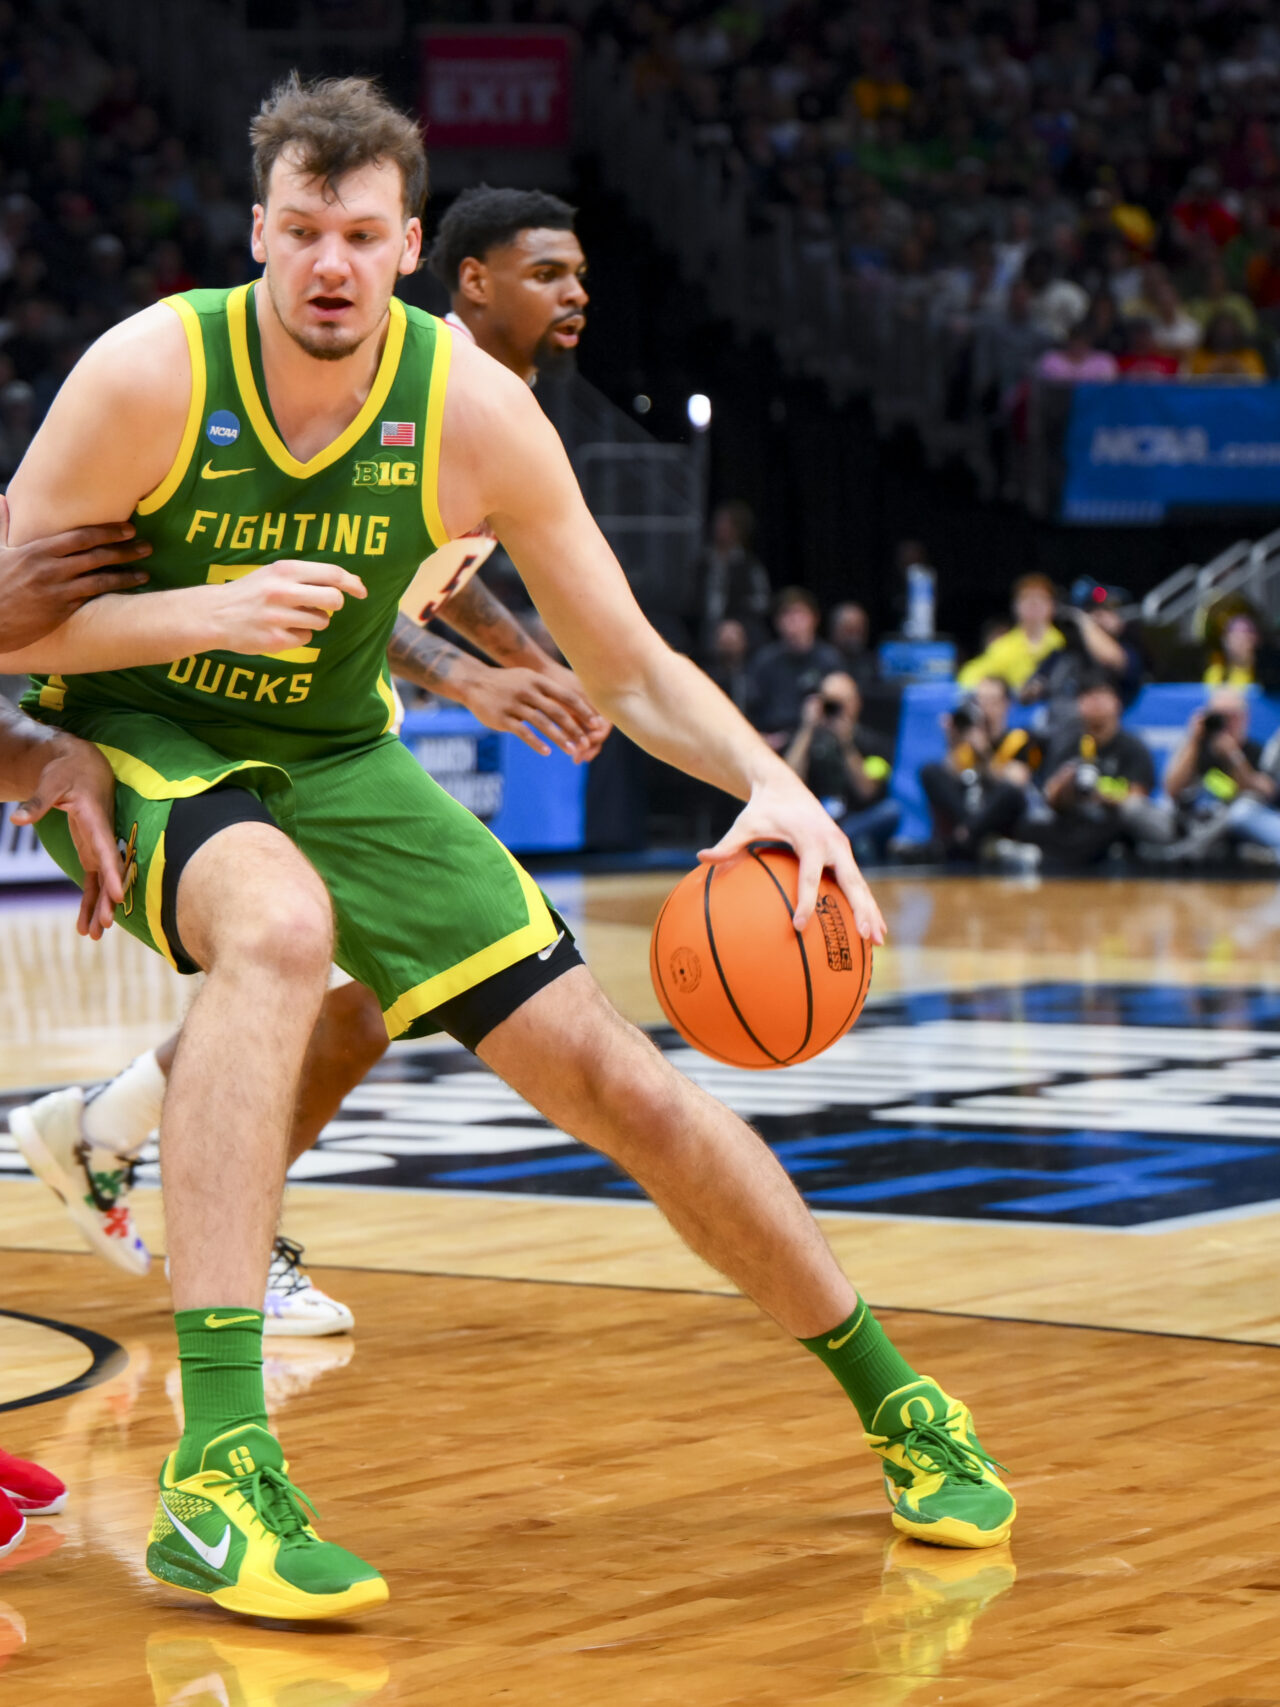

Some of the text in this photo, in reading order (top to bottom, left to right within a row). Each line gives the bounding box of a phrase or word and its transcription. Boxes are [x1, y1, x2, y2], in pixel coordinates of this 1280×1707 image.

[209, 425, 238, 439] NCAA
[185, 509, 390, 556] FIGHTING
[167, 655, 313, 704] DUCKS
